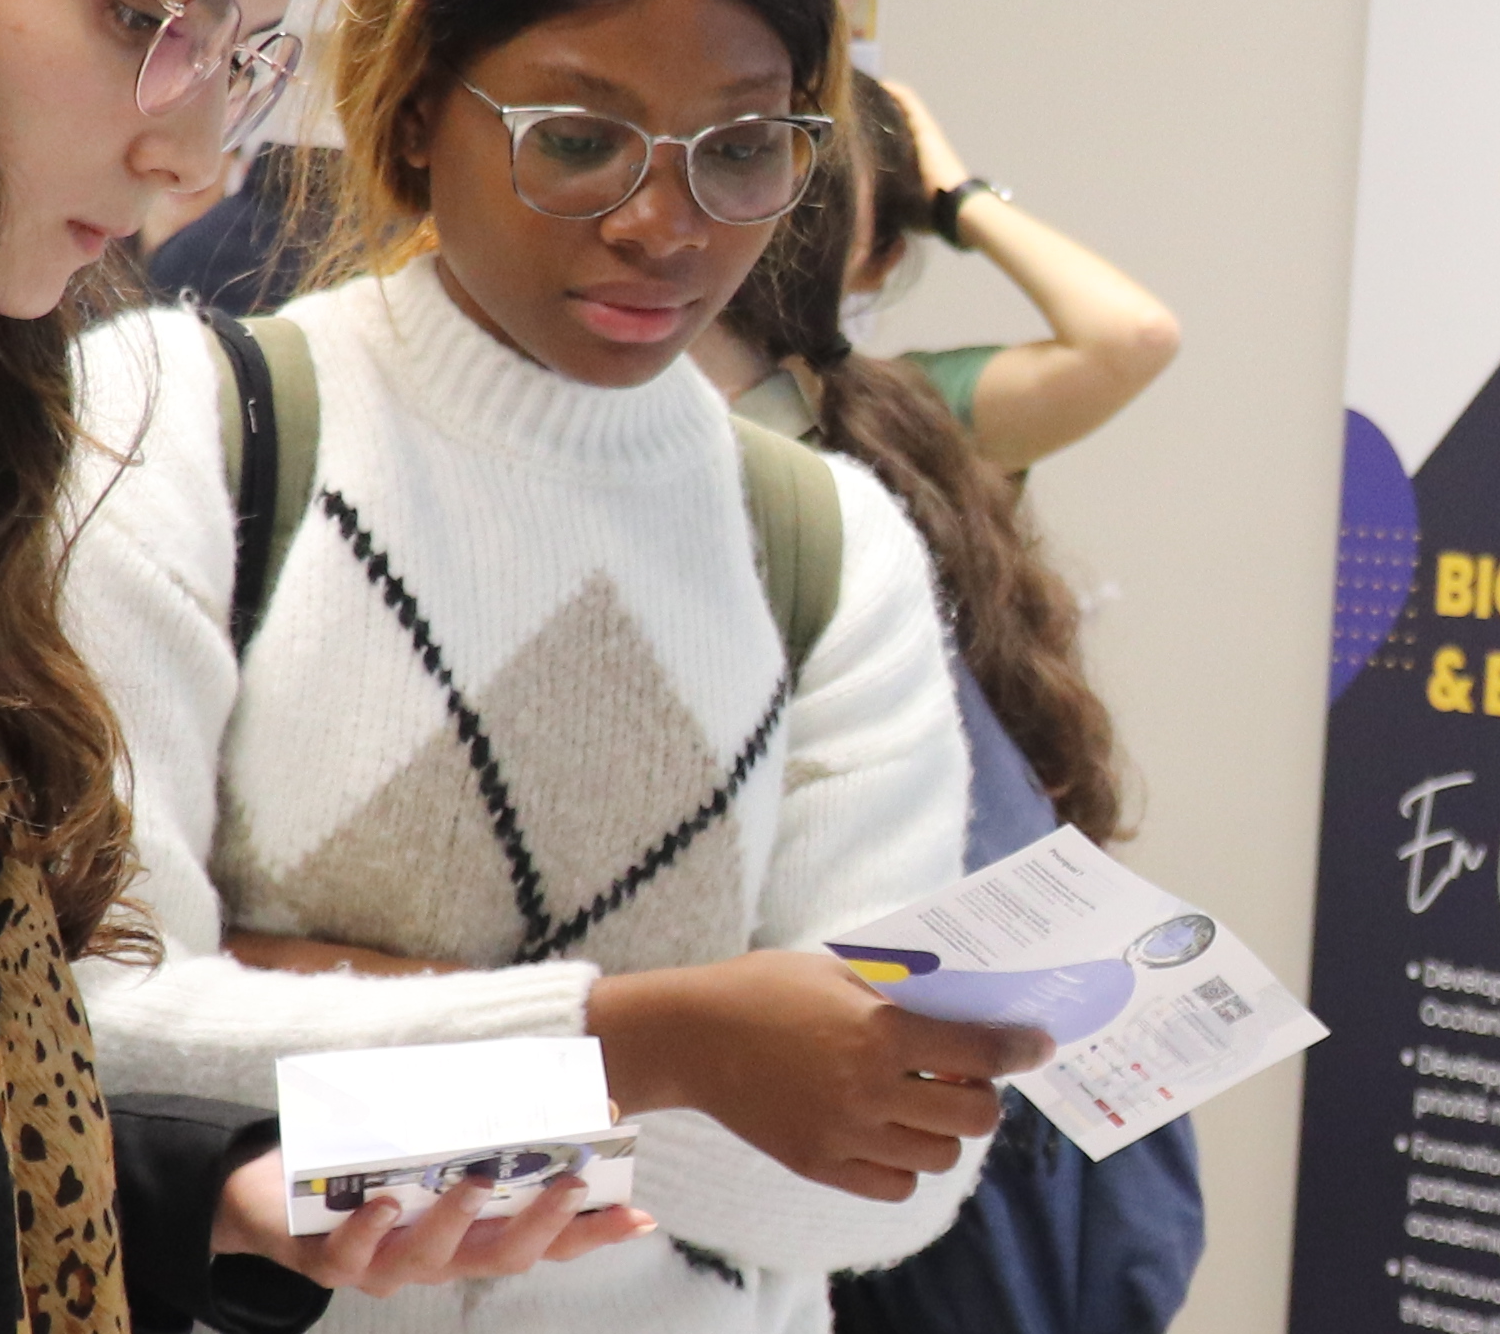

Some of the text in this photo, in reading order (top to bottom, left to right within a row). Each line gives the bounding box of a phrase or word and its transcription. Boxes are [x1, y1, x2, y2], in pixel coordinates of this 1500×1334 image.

[1427, 646, 1474, 713] &
[1397, 771, 1488, 913] En
[1413, 1088, 1487, 1127] priorité
